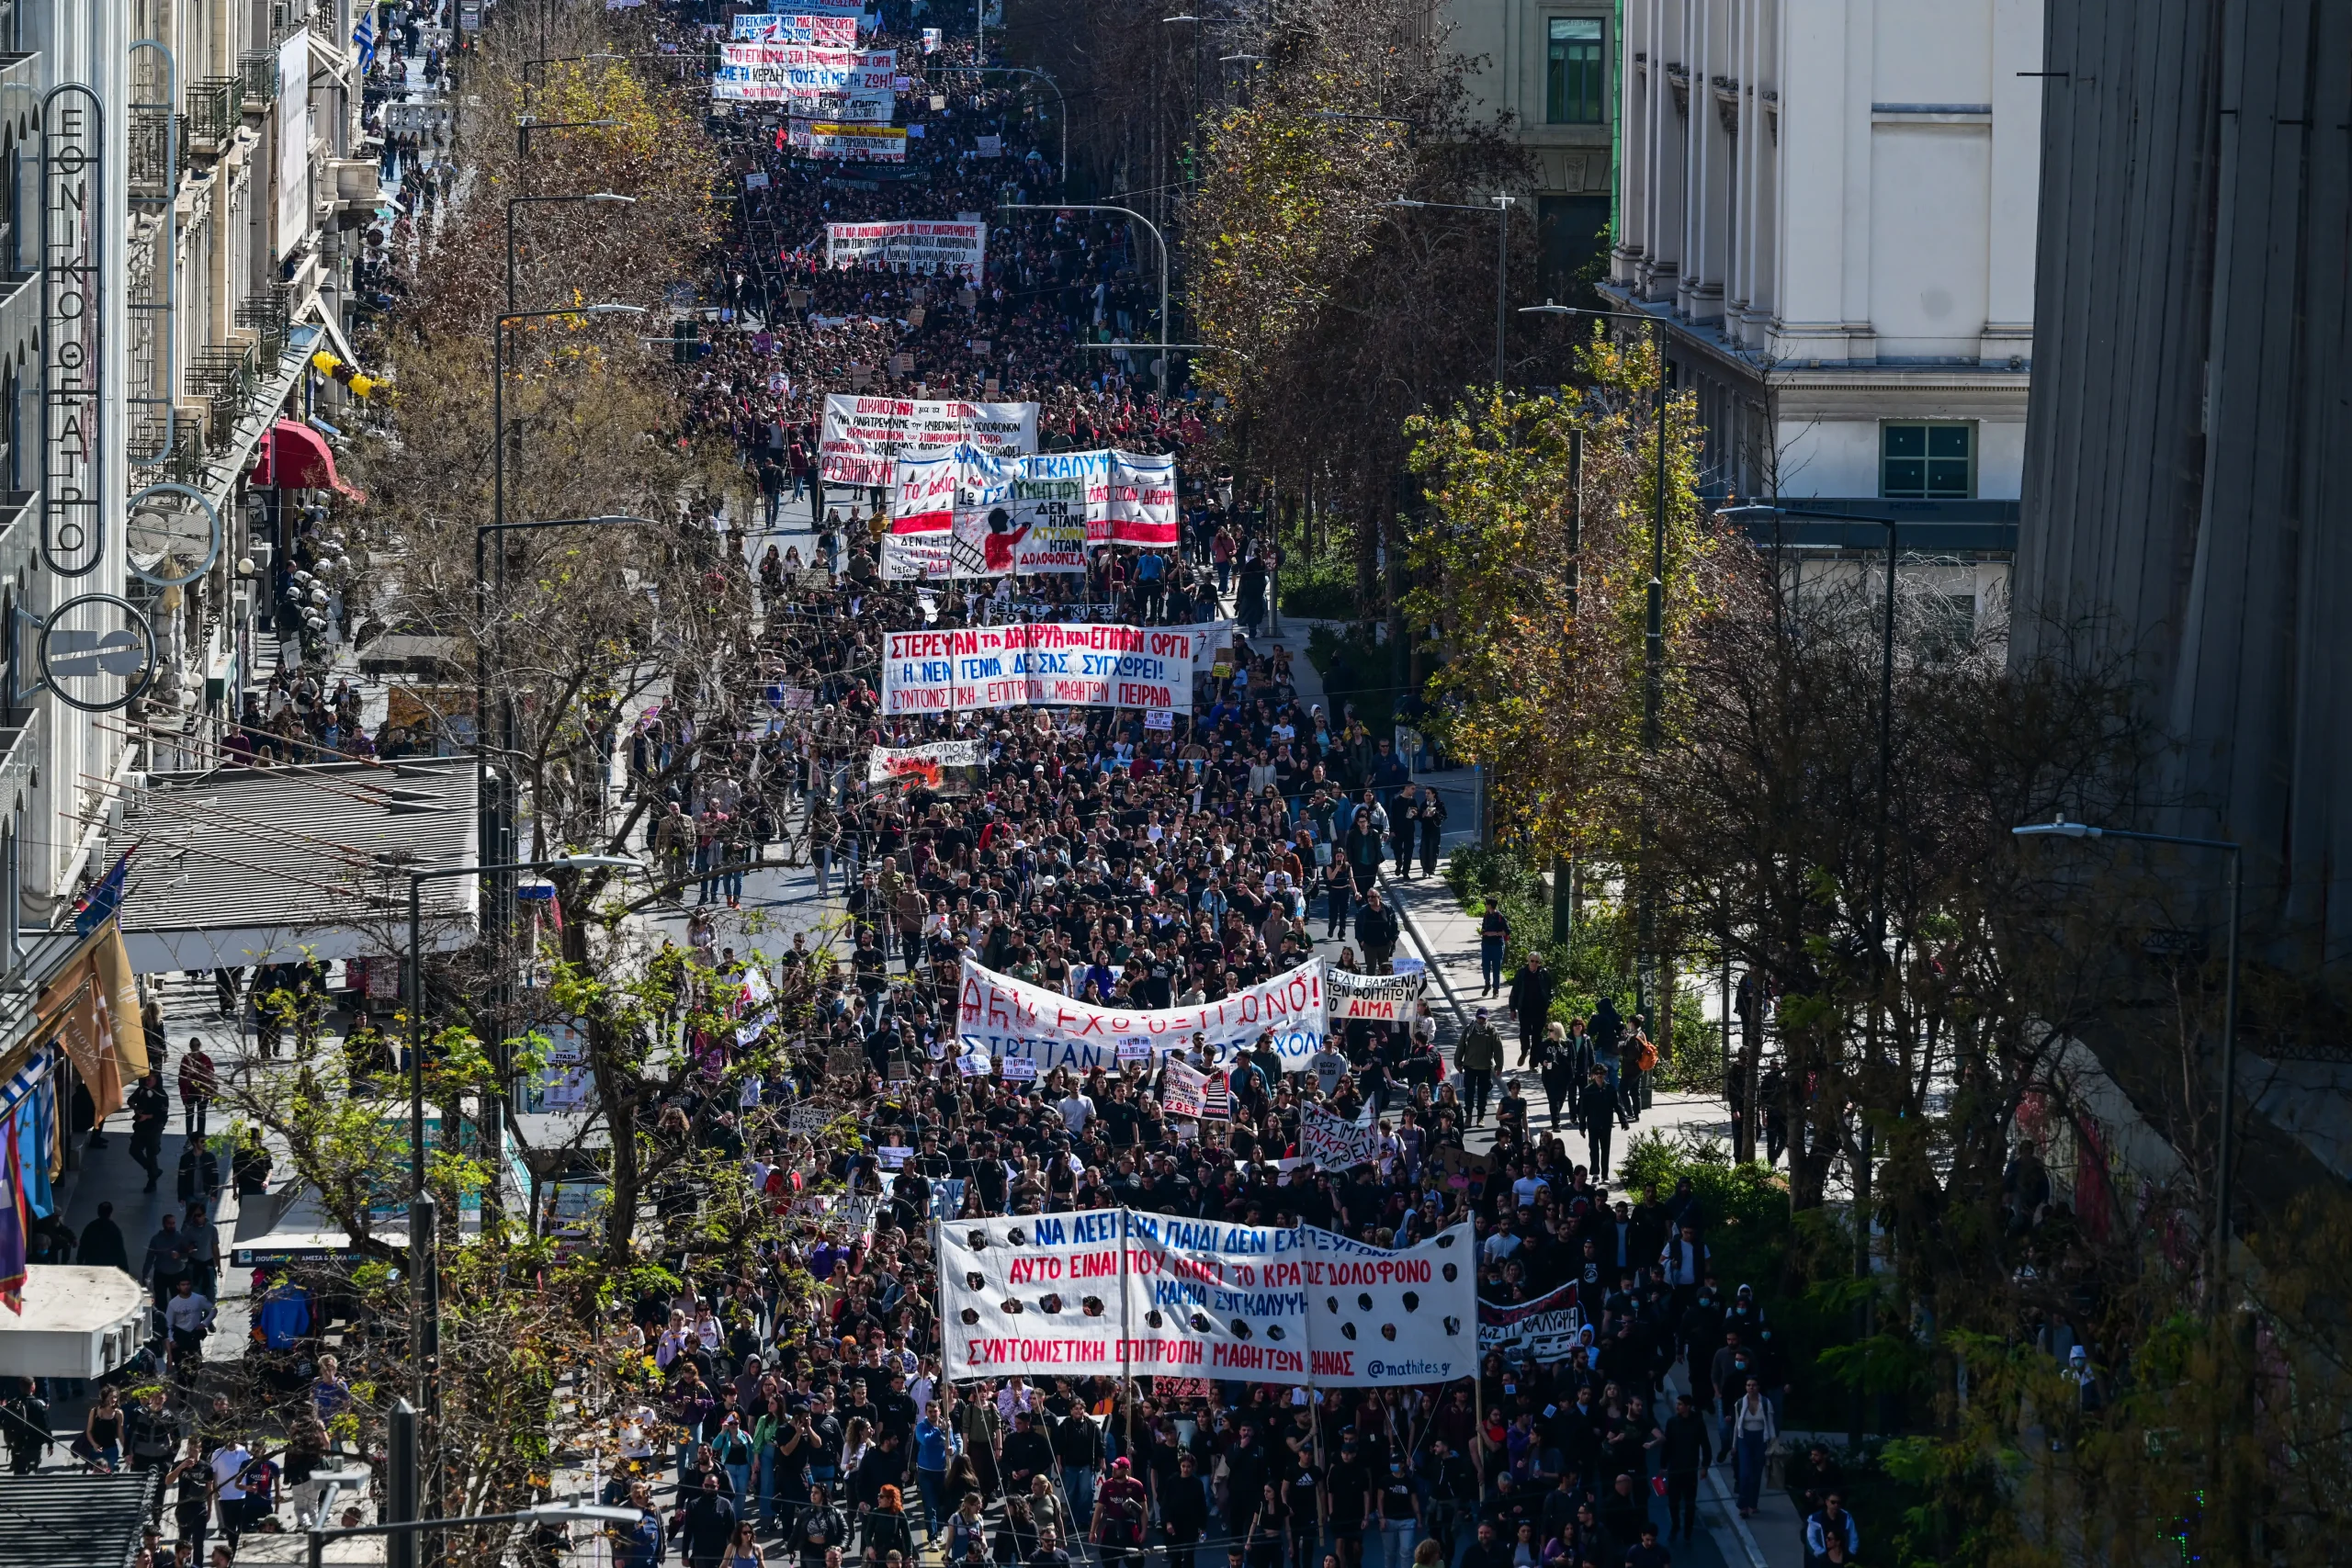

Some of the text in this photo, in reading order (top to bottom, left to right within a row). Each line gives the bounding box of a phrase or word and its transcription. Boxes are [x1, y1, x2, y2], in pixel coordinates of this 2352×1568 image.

[728, 49, 741, 62] ΤΟ
[788, 50, 804, 64] ΣΤΑ
[873, 55, 891, 68] ΟΡΓΗ
[753, 68, 784, 83] ΚΕΡΔΗ
[788, 69, 816, 85] ΤΟΥΣ
[831, 72, 845, 86] ΜΕ
[849, 73, 861, 86] ΤΗ
[59, 109, 85, 319] ΕΘΝΙΚΟ
[833, 226, 843, 237] ΓΙΑ
[845, 226, 856, 237] ΝΑ
[907, 224, 915, 235] ΝΑ
[856, 399, 913, 416] ΔΙΚΑΙΟΣΥΝΗ
[946, 403, 977, 419] ΤΕΜΠΗ
[838, 414, 850, 425] ΝΑ
[853, 415, 910, 430] ΑΝΑΤΡΕΨΟΥΜΕ
[974, 421, 1020, 434] ΔΟΛΟΦΟΝΩΝ
[847, 427, 904, 441] ΚΡΑΤΙΚΟΠΟΙΗΣΗ
[978, 434, 1001, 445] ΤΩΡΑ
[59, 342, 85, 551] ΘΕΑΤΡΟ
[822, 441, 865, 454] ΚΑΤΑΛΗΨΕΙΣ
[1019, 453, 1119, 479] ΣΥΓΚΑΛΥΨΗ
[903, 483, 920, 501] ΤΟ
[1115, 485, 1137, 502] ΣΤΟΝ
[1014, 479, 1080, 500] ΥΜΗΤΤΟΥ
[1035, 502, 1068, 515] ΔΕΝ
[1049, 514, 1086, 527] ΗΤΑΝΕ
[900, 536, 922, 547] ΔΕΝ
[1032, 527, 1087, 540] ΑΤΥΧΗΜΑ
[910, 549, 941, 558] ΗΤΑΝ
[1049, 540, 1082, 553] ΗΤΑΝ
[1020, 551, 1087, 566] ΔΟΛΟΦΟΝΙΑ
[891, 630, 978, 659] ΣΤΕΡΕΨΑΝ
[981, 634, 1001, 649] ΤΑ
[1005, 625, 1064, 650] ΔΑΚΡΥΑ
[1066, 631, 1090, 647] ΚΑΙ
[1091, 626, 1145, 653] ΕΓΙΝΑΝ
[1150, 633, 1189, 660] ΟΡΓΗ
[904, 653, 1163, 682] Η ΝΕΑ ΓΕΝΙΑ ΔΕ ΣΑΣ ΣΥΓΧΩΡΕΙ!
[891, 680, 1171, 709] ΣΥΝΤΟΝΙΣΤΙΚΗ ΕΠΙΤΡΟΠΗ ΜΑΘΗΤΩΝ ΠΕΙΡΑΙΑ
[937, 742, 967, 753] ΟΠΟΥ
[1364, 974, 1418, 988] ΒΑΜΜΕΝΑ
[1327, 983, 1414, 1001] ΤΩΝ ΦΟΙΤΗΤΩΝ
[1349, 999, 1393, 1018] ΑΙΜΑ
[1165, 1100, 1198, 1115] ΖΩΕΣ
[1035, 1212, 1266, 1253] ΝΑ ΛΕΕΙ ΕΝΑ ΠΑΙΔΙ ΔΕΝ
[1010, 1257, 1062, 1284] ΑΥΤΟ
[1070, 1251, 1117, 1279] ΕΙΝΑΙ
[1124, 1249, 1167, 1275] ΠΟΥ
[1174, 1258, 1224, 1286] ΚΑΝΕΙ
[1231, 1265, 1255, 1288] ΤΟ
[1328, 1258, 1431, 1286] ΔΟΛΟΦΟΝΟ
[1156, 1280, 1308, 1316] ΚΑΜΙΑ ΣΥΓΚΑΛΥΨΗ
[967, 1338, 1303, 1372] ΣΥΝΤΟΝΙΣΤΙΚΗ ΕΠΙΤΡΟΠΗ ΜΑΘΗΤΩΝ
[1367, 1359, 1452, 1378] @mathites.gr
